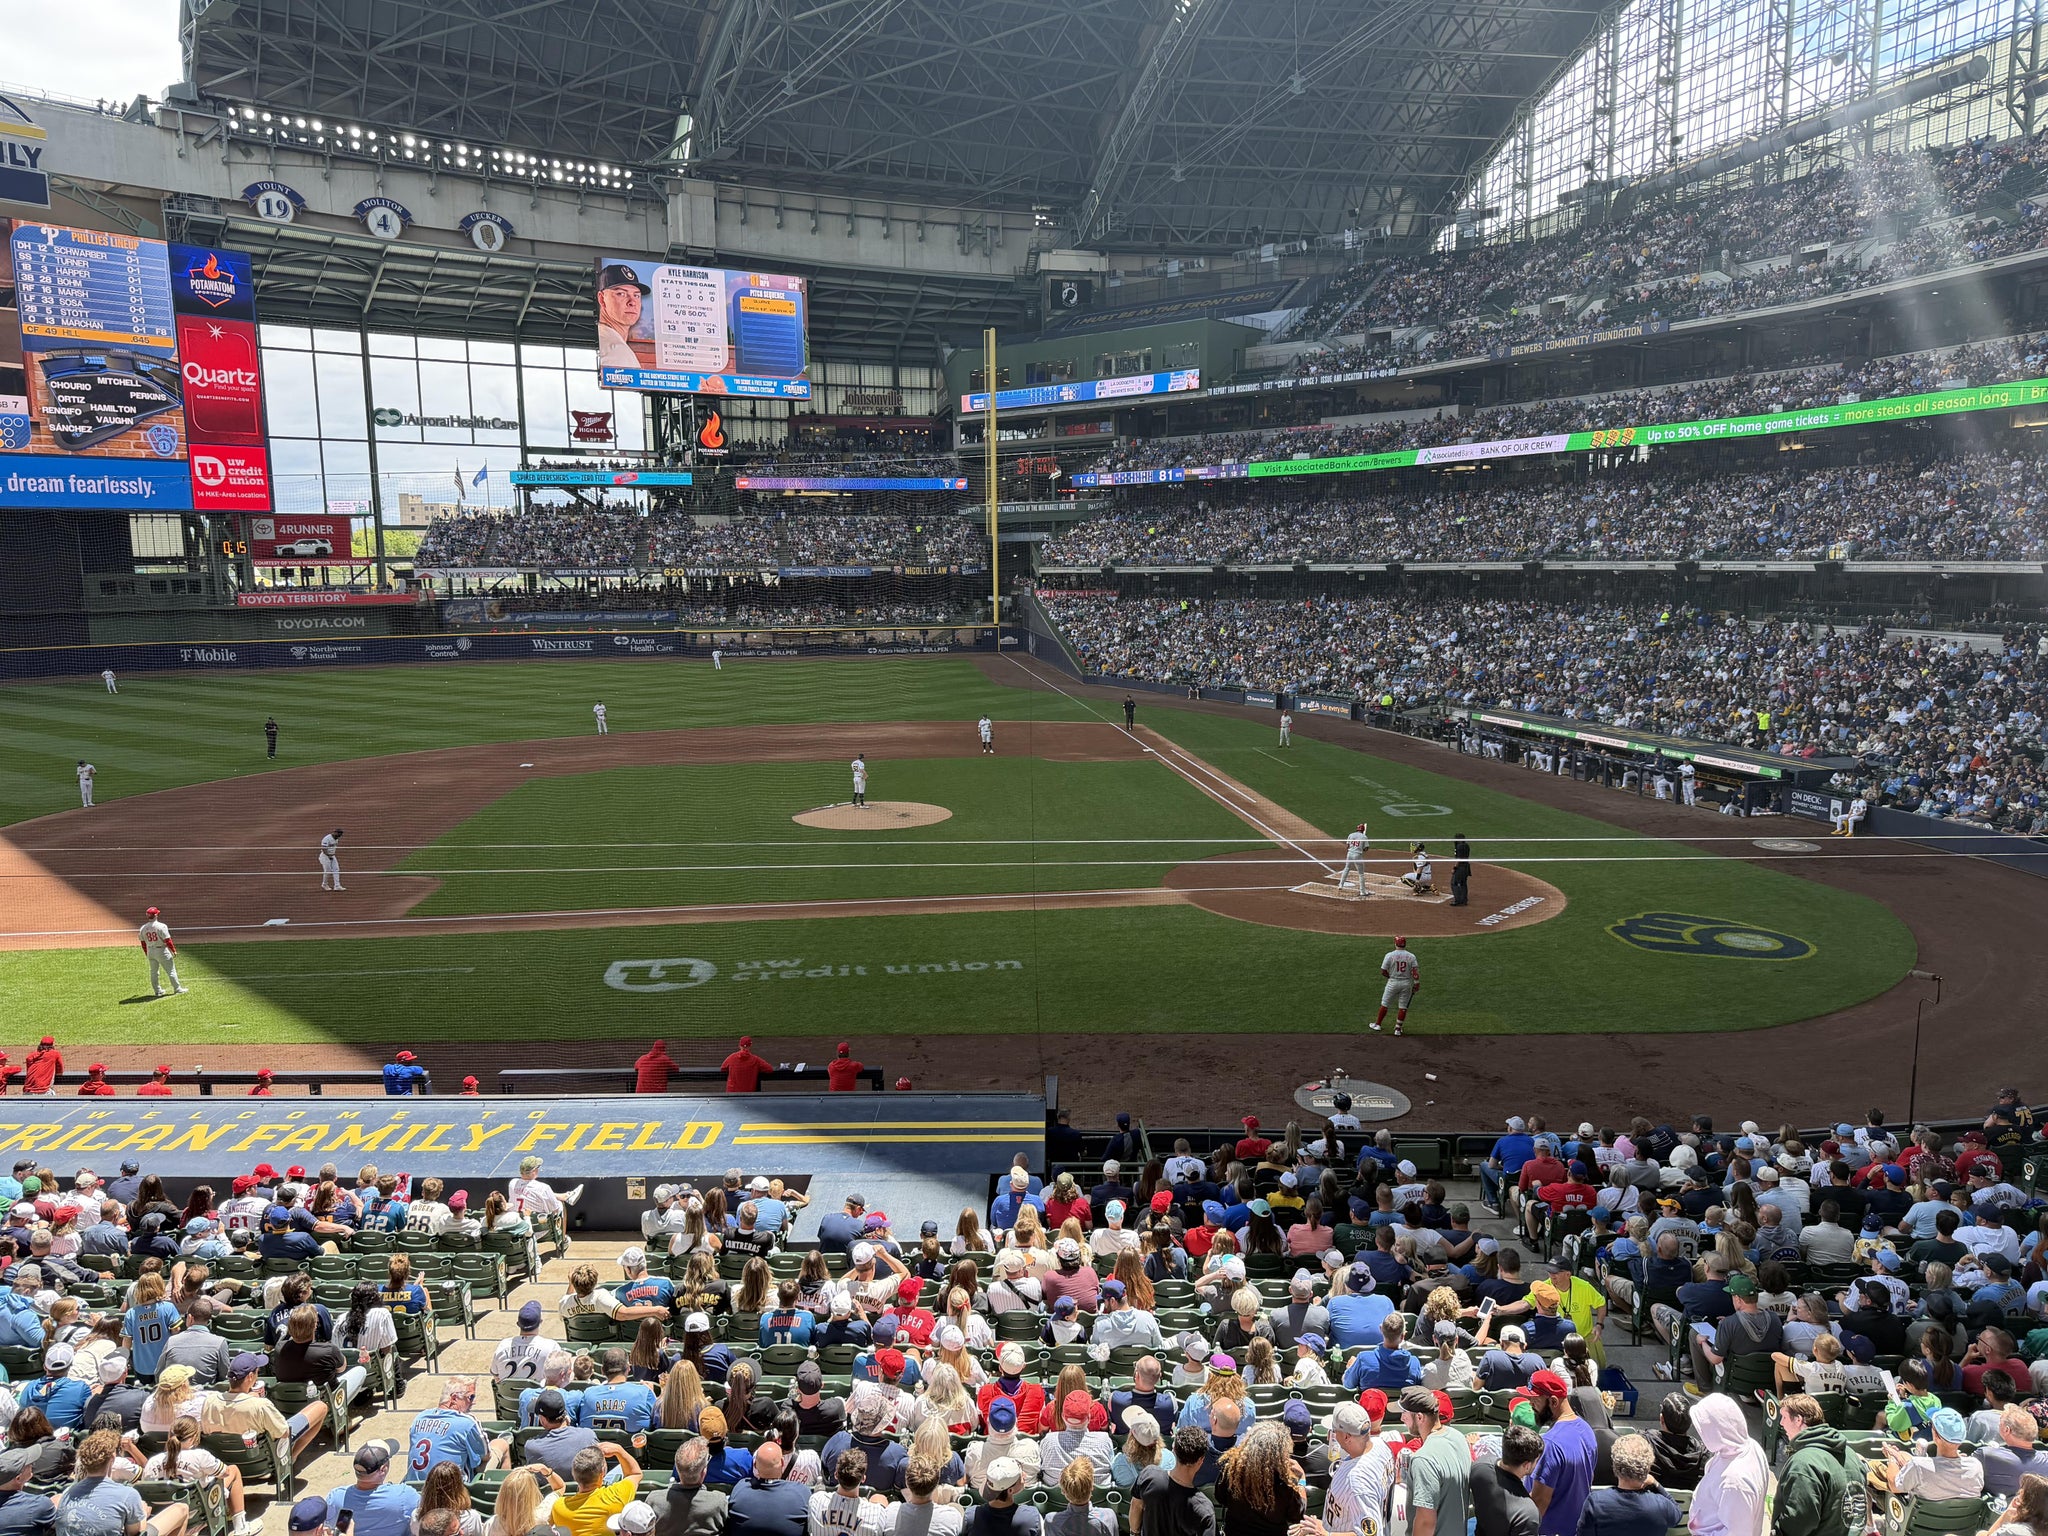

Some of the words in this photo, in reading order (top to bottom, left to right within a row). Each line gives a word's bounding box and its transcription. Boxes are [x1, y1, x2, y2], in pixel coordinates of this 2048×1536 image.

[257, 182, 292, 196] YOUNT
[262, 197, 289, 219] 19
[362, 200, 403, 214] MOLITOR
[377, 214, 390, 232] 4
[470, 214, 503, 224] UECKER
[71, 232, 109, 247] PHILLIES
[110, 236, 140, 250] LINEUP
[17, 241, 31, 250] DH
[38, 244, 47, 252] 12
[53, 246, 108, 260] SCHWARBER
[18, 252, 32, 261] SS
[40, 254, 46, 262] 7
[55, 256, 89, 268] TURNER
[41, 265, 48, 273] 3
[56, 267, 90, 279] HARPER
[668, 269, 681, 278] KYLE
[682, 270, 709, 280] HARRISON
[21, 272, 34, 281] 3B
[39, 275, 52, 284] 28
[57, 278, 82, 287] BOHM
[22, 283, 35, 292] RF
[58, 287, 89, 298] MARSH
[190, 279, 236, 296] POTAWATOMI
[24, 294, 35, 302] LF
[59, 298, 84, 308] SOSA
[25, 304, 37, 313] 2B
[60, 308, 90, 318] STOTT
[1079, 315, 1115, 325] MUST
[1118, 311, 1135, 319] BE
[1137, 308, 1153, 316] IN
[1155, 303, 1181, 314] THE
[1182, 297, 1228, 311] FRONT
[45, 317, 55, 325] 13
[61, 318, 104, 331] MARCHAN
[27, 326, 39, 334] CF
[45, 327, 57, 335] 49
[62, 329, 81, 337] HILL
[1511, 344, 1543, 356] BREWERS
[1545, 334, 1590, 351] COMMUNITY
[1593, 326, 1643, 343] FOUNDATION
[183, 362, 257, 387] Quartz
[51, 381, 92, 391] CHOURIO
[97, 377, 142, 388] MITCHELL
[214, 383, 226, 391] Find
[227, 385, 239, 393] your
[1263, 382, 1273, 390] TEXT
[58, 395, 86, 404] ORTIZ
[130, 391, 167, 401] PERKINS
[12, 401, 19, 409] 7
[42, 406, 82, 416] RENGIFO
[90, 403, 137, 414] HAMILTON
[95, 416, 134, 425] VAUGHN
[408, 412, 448, 427] Aurora
[449, 415, 489, 429] Health
[491, 417, 518, 430] Care
[1648, 430, 1662, 443] Up
[1664, 429, 1675, 440] to
[1678, 425, 1700, 438] 50%
[1702, 423, 1726, 436] OFF
[1730, 419, 1763, 432] home
[1765, 418, 1793, 432] game
[1796, 412, 1829, 425] tickets
[1845, 409, 1874, 421] more
[1877, 403, 1911, 417] steals
[1914, 400, 1929, 413] all
[1931, 396, 1976, 410] season
[1978, 392, 2012, 408] long.
[49, 423, 93, 433] SÁNCHEZ
[1432, 450, 1474, 460] AssociatedBank
[1480, 446, 1499, 455] BANK
[1501, 444, 1511, 454] OF
[1513, 443, 1530, 453] OUR
[1531, 441, 1553, 451] CREW
[227, 458, 245, 467] uw
[1264, 464, 1282, 474] Visit
[1284, 456, 1401, 472] AssociatedBank.com/Brewers
[228, 467, 263, 477] credit
[1159, 469, 1173, 481] 81
[8, 473, 65, 493] dream
[68, 474, 156, 499] fearlessly.
[229, 476, 264, 486] union
[1079, 476, 1095, 484] 1:42
[205, 491, 236, 499] MKE-Area
[280, 525, 334, 535] 4RUNNER
[223, 541, 247, 554] 0:15
[664, 568, 684, 577] 620
[686, 568, 719, 577] WTMJ
[905, 566, 932, 575] NICOLET
[934, 566, 947, 574] LAW
[240, 595, 286, 604] TOYOTA
[287, 593, 347, 603] TERRITORY
[275, 617, 366, 630] TOYOTA.COM
[532, 639, 593, 650] WINTRUST
[630, 637, 655, 645] Aurora
[309, 645, 361, 654] Northwestern
[425, 644, 453, 652] Johnson
[430, 650, 459, 658] Controls
[195, 649, 237, 661] Mobile
[310, 651, 337, 660] Mutual
[1792, 792, 1802, 800] ON
[1803, 794, 1822, 804] DECK:
[145, 931, 158, 942] 88
[732, 964, 868, 980] credit
[885, 959, 1024, 975] union
[736, 958, 805, 970] uw
[1396, 961, 1407, 973] 12
[2015, 1108, 2034, 1127] 75
[227, 1123, 514, 1151] FAMILY
[512, 1121, 724, 1151] FIELD
[1603, 1153, 1618, 1161] LEE
[516, 1198, 523, 1212] 7
[1566, 1194, 1583, 1203] UTLEY
[229, 1216, 248, 1229] 61
[364, 1214, 388, 1232] 22
[407, 1215, 430, 1232] 28
[725, 1240, 761, 1253] CONTRERAS
[625, 1285, 658, 1301] CHOURIO
[768, 1315, 801, 1328] CHOURIO
[139, 1323, 162, 1344] 10
[774, 1331, 791, 1344] 11
[504, 1346, 541, 1358] YELICH
[1849, 1372, 1885, 1388] FRELICK
[595, 1399, 626, 1412] ARIAS
[414, 1419, 450, 1437] HARPER
[412, 1438, 432, 1471] 3
[822, 1509, 863, 1532] KELLY
